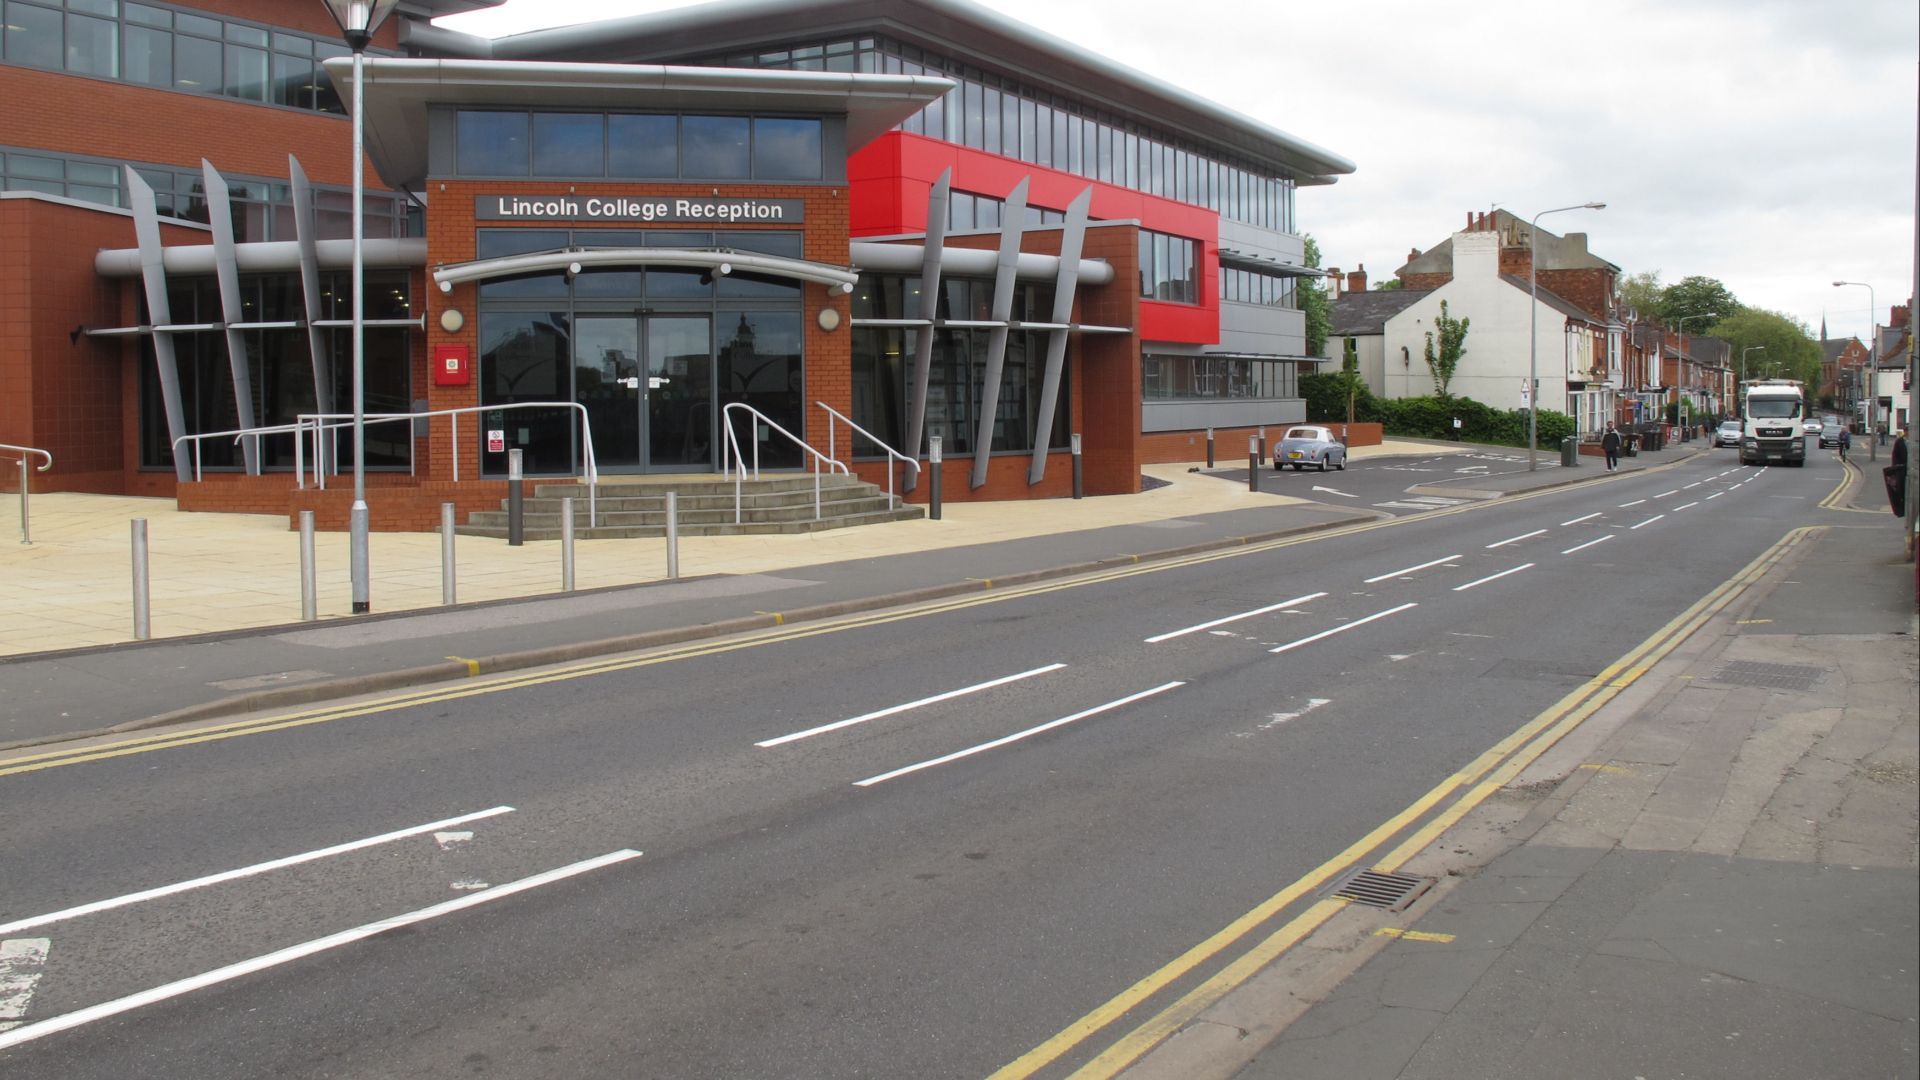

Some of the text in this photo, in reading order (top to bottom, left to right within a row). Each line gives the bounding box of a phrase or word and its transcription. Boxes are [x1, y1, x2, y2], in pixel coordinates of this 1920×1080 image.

[498, 197, 783, 222] Lincoln College Reception
